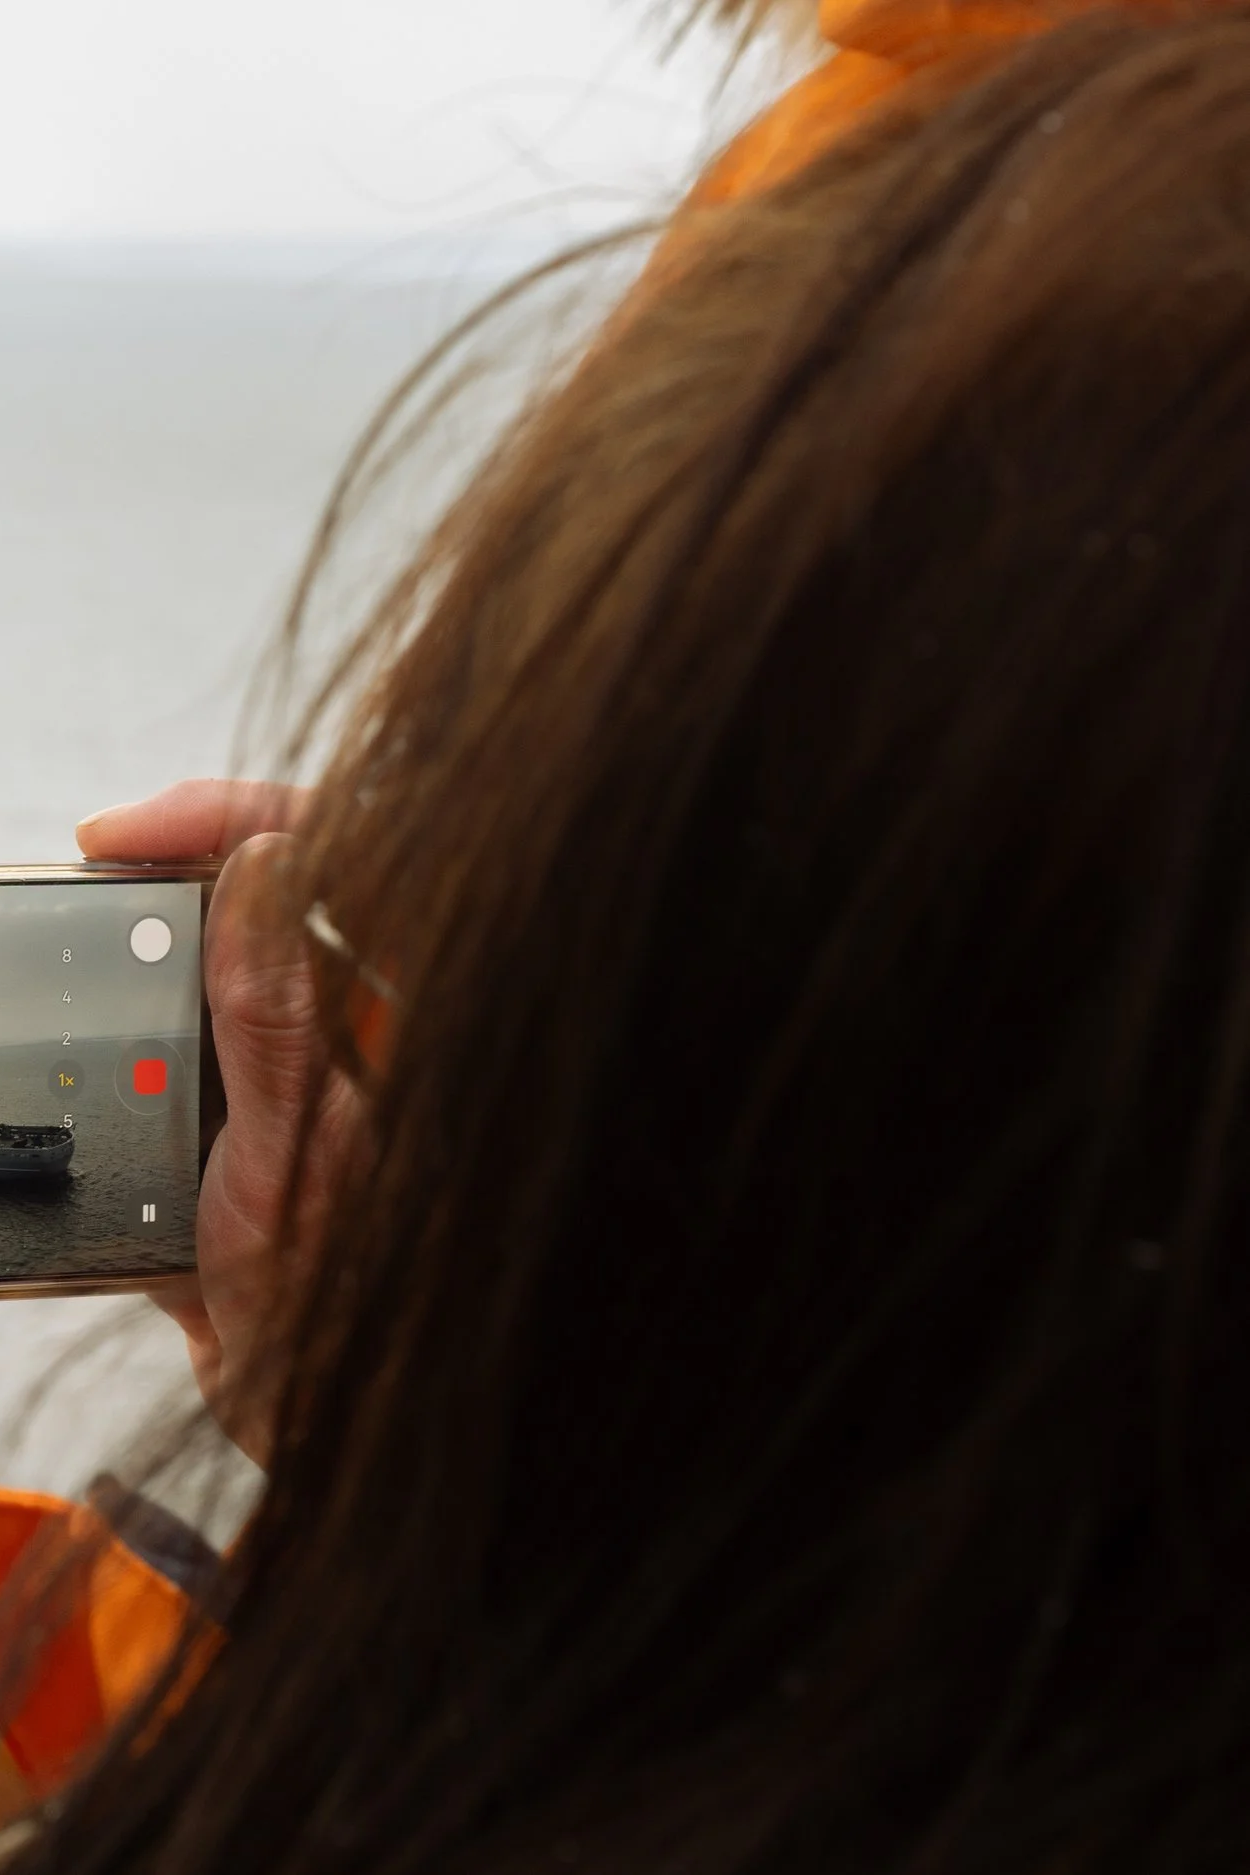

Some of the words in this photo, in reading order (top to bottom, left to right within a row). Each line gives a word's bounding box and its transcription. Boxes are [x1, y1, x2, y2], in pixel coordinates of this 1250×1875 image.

[62, 948, 72, 963] 8
[62, 990, 72, 1004] 4
[62, 1031, 71, 1046] 2
[58, 1072, 75, 1087] 1x
[59, 1114, 73, 1128] .5
